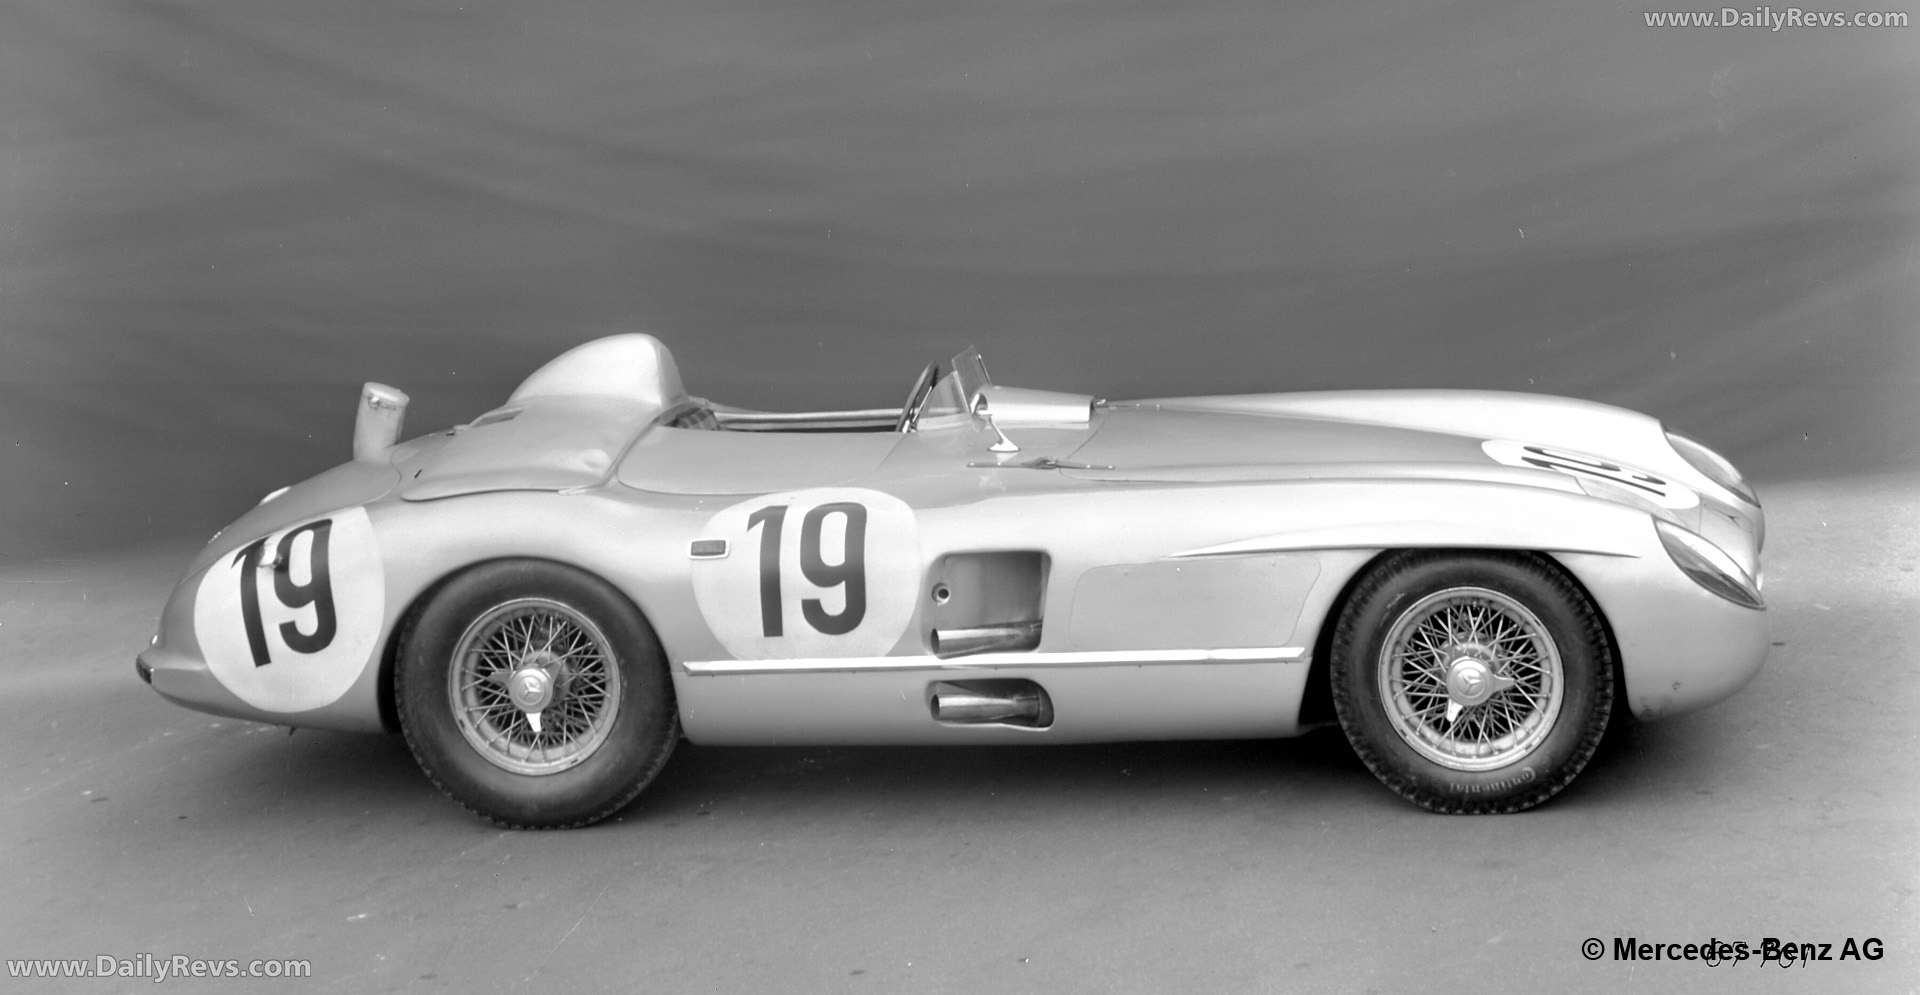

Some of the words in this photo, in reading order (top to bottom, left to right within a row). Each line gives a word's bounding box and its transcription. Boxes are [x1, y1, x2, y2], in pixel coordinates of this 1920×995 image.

[1520, 445, 1667, 498] 19
[231, 518, 337, 668] 19
[747, 501, 867, 637] 19
